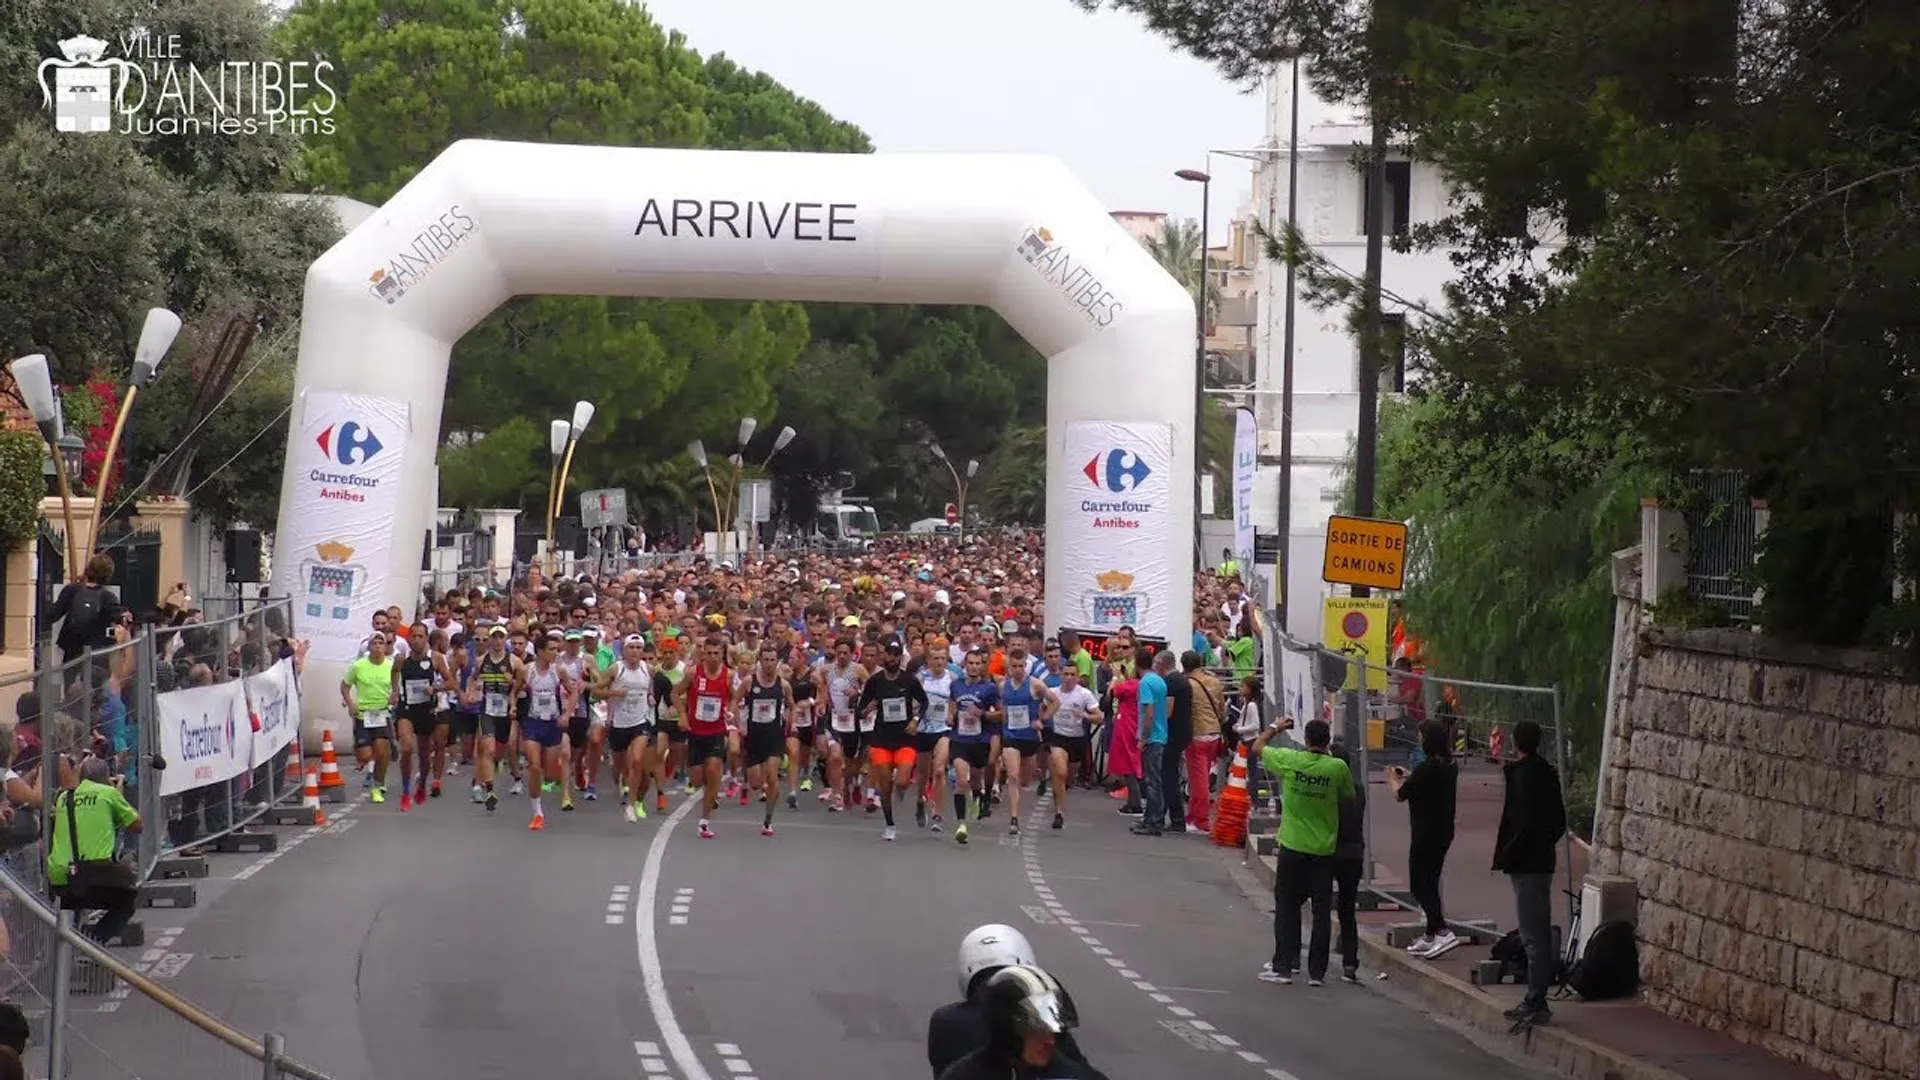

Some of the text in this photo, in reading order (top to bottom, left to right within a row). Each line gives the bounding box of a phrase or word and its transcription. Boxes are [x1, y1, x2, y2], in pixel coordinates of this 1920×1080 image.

[634, 198, 857, 241] ARRIVEE
[389, 204, 474, 287] ANTIBES
[1036, 246, 1123, 326] ANTIBES
[310, 469, 380, 487] Carrefour
[320, 488, 365, 502] Antibes
[1081, 501, 1151, 512] Carrefour
[1093, 517, 1140, 528] Antibes
[1331, 530, 1402, 550] SORTIE DE
[1332, 555, 1395, 575] CAMIONS
[180, 712, 222, 762] Carrefour
[1293, 770, 1330, 787] Topfit
